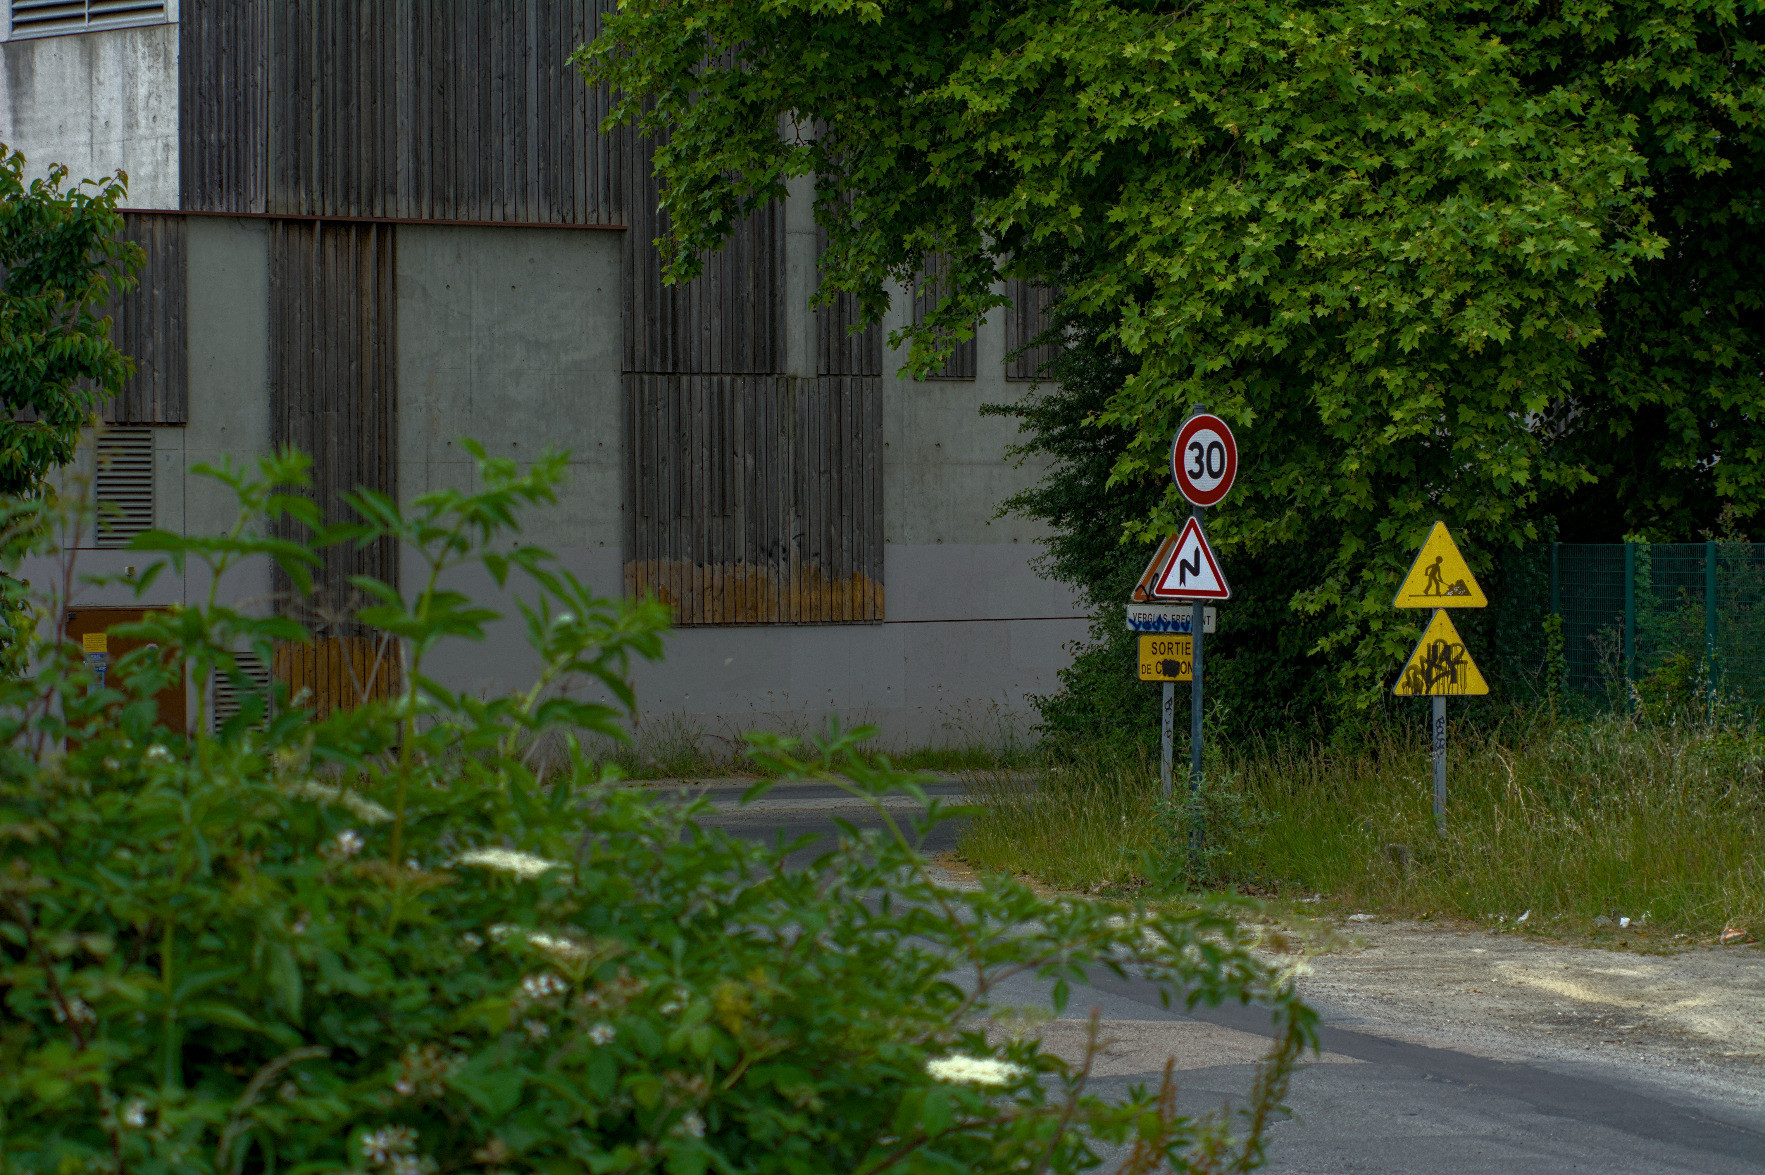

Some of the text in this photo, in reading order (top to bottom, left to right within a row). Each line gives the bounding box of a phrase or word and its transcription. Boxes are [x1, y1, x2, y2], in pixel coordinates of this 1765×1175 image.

[1188, 441, 1225, 480] 30
[1132, 613, 1167, 623] VERGLS
[1151, 642, 1191, 655] SORTIE
[1141, 664, 1151, 674] DE
